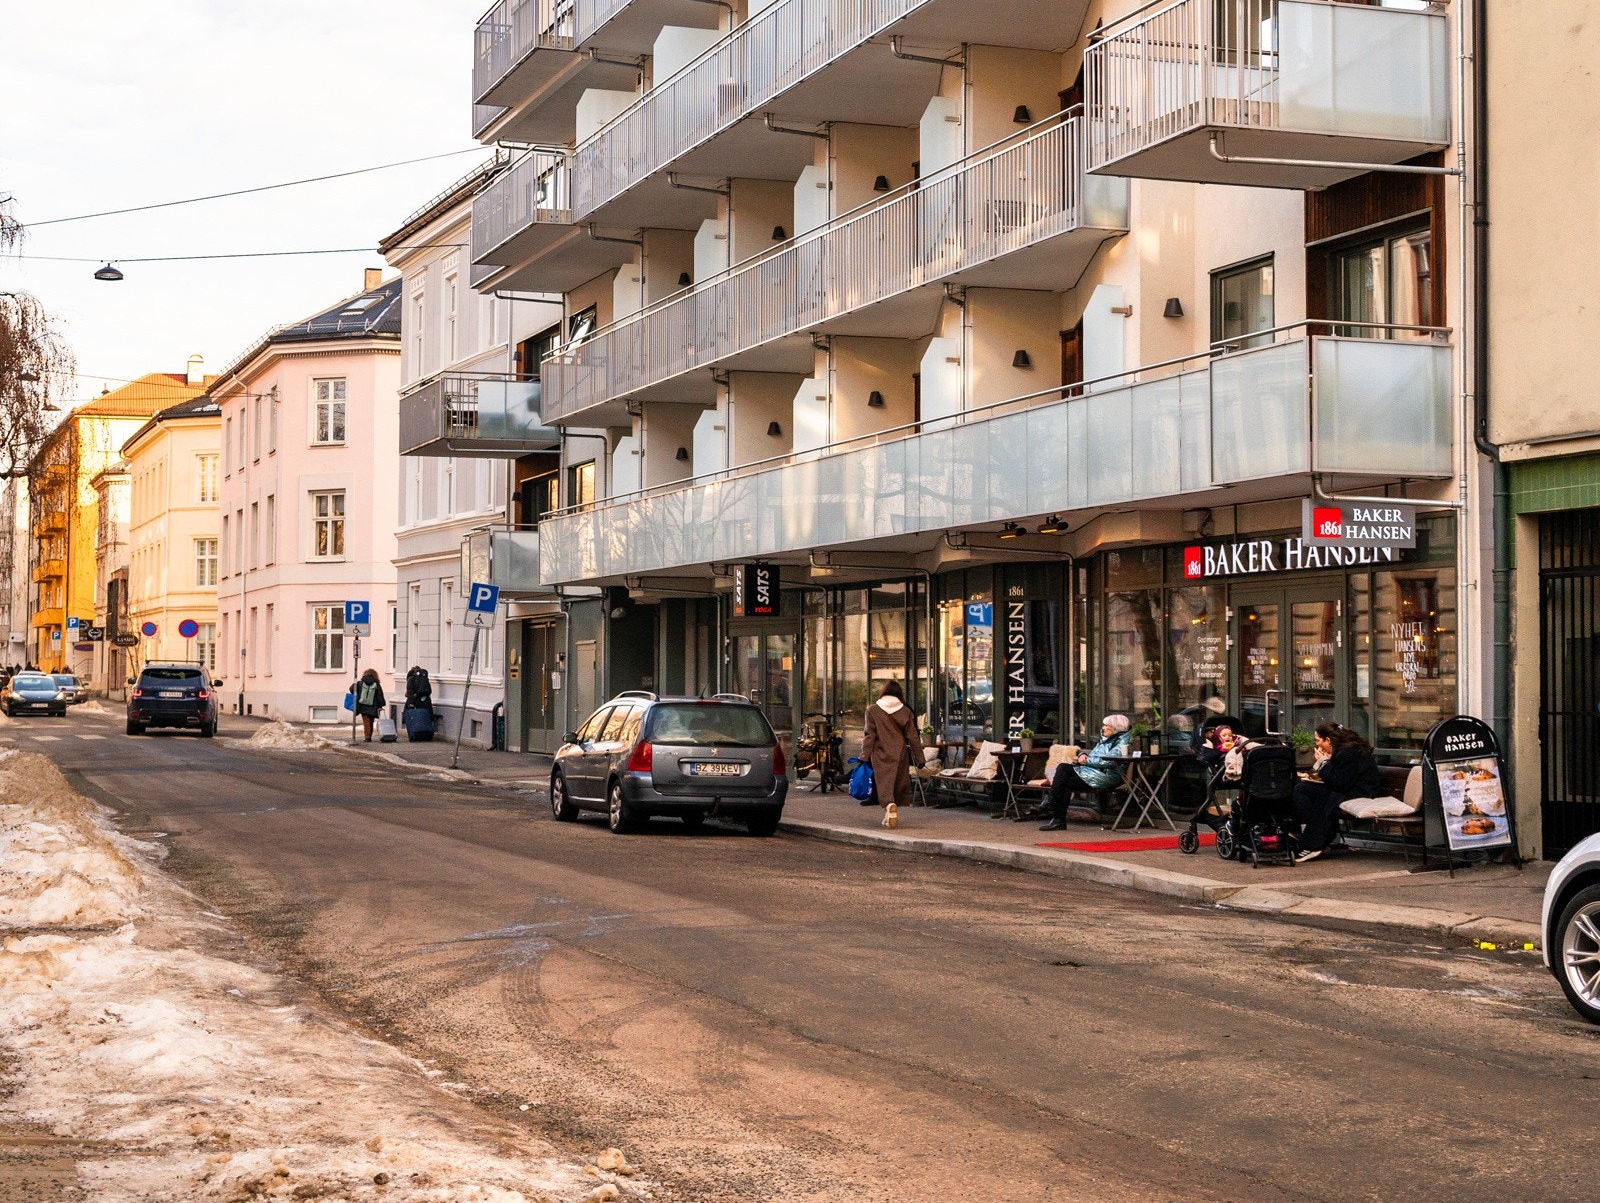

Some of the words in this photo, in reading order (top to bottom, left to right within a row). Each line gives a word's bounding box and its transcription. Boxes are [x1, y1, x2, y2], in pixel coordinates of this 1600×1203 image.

[1353, 508, 1405, 522] BAKER
[1320, 521, 1342, 535] 1861
[1345, 525, 1411, 540] HANSEN
[1188, 560, 1201, 575] 1861
[1203, 540, 1277, 576] BAKER
[757, 568, 769, 605] SATS
[1008, 586, 1024, 596] 1861
[475, 587, 491, 608] P
[351, 603, 363, 621] P
[69, 618, 76, 627] P
[1008, 601, 1025, 704] HANSEN
[695, 764, 707, 772] BZ
